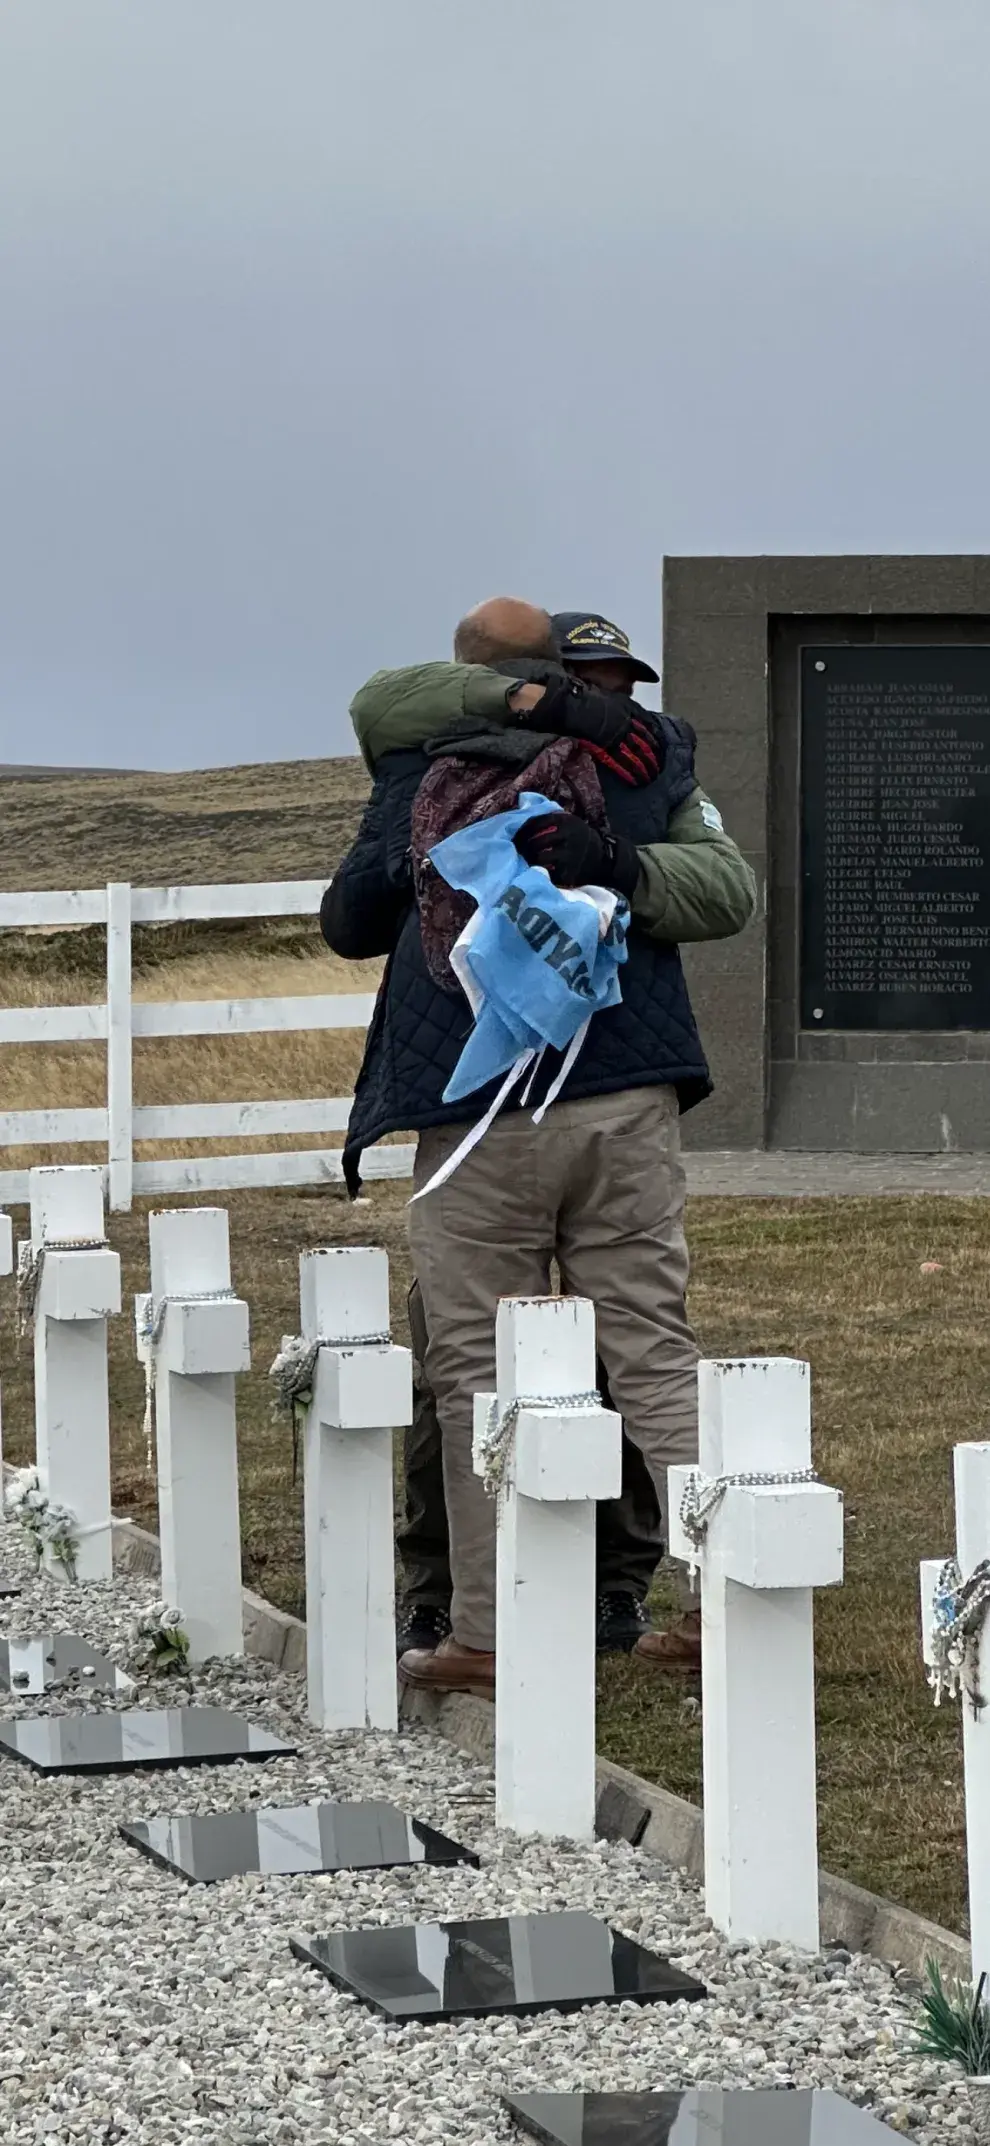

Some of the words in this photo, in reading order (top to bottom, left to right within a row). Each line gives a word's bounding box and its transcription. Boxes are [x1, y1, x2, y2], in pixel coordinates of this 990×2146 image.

[888, 683, 916, 692] JUAN
[919, 683, 953, 692] OMAR
[884, 695, 932, 704] IGNACIO
[935, 695, 987, 704] ALFREDO
[825, 707, 868, 716] ACOSTA
[868, 718, 896, 727] JUAN
[913, 729, 957, 739] NESTOR
[825, 741, 876, 750] AGUILAR
[881, 741, 930, 750] EUSEBIO
[933, 741, 984, 750] ANTONIO
[825, 753, 883, 762] AGUILERA
[888, 753, 913, 762] LUIS
[915, 753, 971, 762] ORLANDO
[825, 765, 875, 774] AGUIRRE
[880, 765, 933, 774] ALBERTO
[825, 776, 875, 785] AGUIRRE
[880, 776, 912, 785] FELIX
[916, 776, 968, 785] ERNESTO
[825, 788, 875, 797] AGUIRRE
[880, 788, 927, 797] HECTOR
[931, 788, 976, 797] WALTER
[825, 800, 875, 809] AGUIRRE
[881, 800, 909, 809] JUAN
[912, 800, 940, 809] JOSE
[825, 812, 873, 820] AGUIRRE
[880, 812, 925, 820] MIGUEL
[825, 823, 882, 832] AHUMADA
[887, 823, 920, 832] HUGO
[923, 823, 963, 832] DARDO
[825, 835, 882, 843] AHUMADA
[887, 835, 920, 843] JULIO
[924, 835, 960, 843] CESAR
[825, 846, 876, 855] ALANCAY
[883, 846, 921, 855] MARIO
[924, 846, 980, 855] ROLANDO
[825, 858, 876, 866] ALBELOS
[880, 858, 928, 866] MANUEL
[931, 858, 984, 866] ALBERTO
[825, 869, 870, 877] ALEGRE
[874, 869, 911, 877] CELSO
[824, 881, 870, 889] ALEGRE
[875, 881, 904, 889] RAUL
[824, 892, 872, 901] ALEMAN
[877, 892, 940, 901] HUMBERTO
[942, 892, 980, 901] CESAR
[824, 904, 868, 912] ALFARO
[874, 904, 919, 912] MIGUEL
[921, 904, 974, 912] ALBERTO
[824, 915, 878, 924] ALLENDE
[881, 915, 908, 924] JOSE
[912, 915, 937, 924] LUIS
[824, 926, 881, 935] ALMARAZ
[885, 926, 959, 935] BERNARDINO
[825, 938, 878, 946] ALMIRON
[883, 938, 928, 946] WALTER
[825, 949, 893, 957] ALMONACID
[898, 949, 937, 957] MARIO
[825, 961, 874, 969] ALVAREZ
[879, 961, 915, 969] CESAR
[919, 961, 971, 969] ERNESTO
[824, 972, 875, 981] ALVAREZ
[879, 972, 917, 981] OSCAR
[920, 972, 968, 981] MANUEL
[824, 983, 875, 992] ALVAREZ
[879, 983, 916, 992] RUBEN
[920, 983, 972, 992] HORACIO
